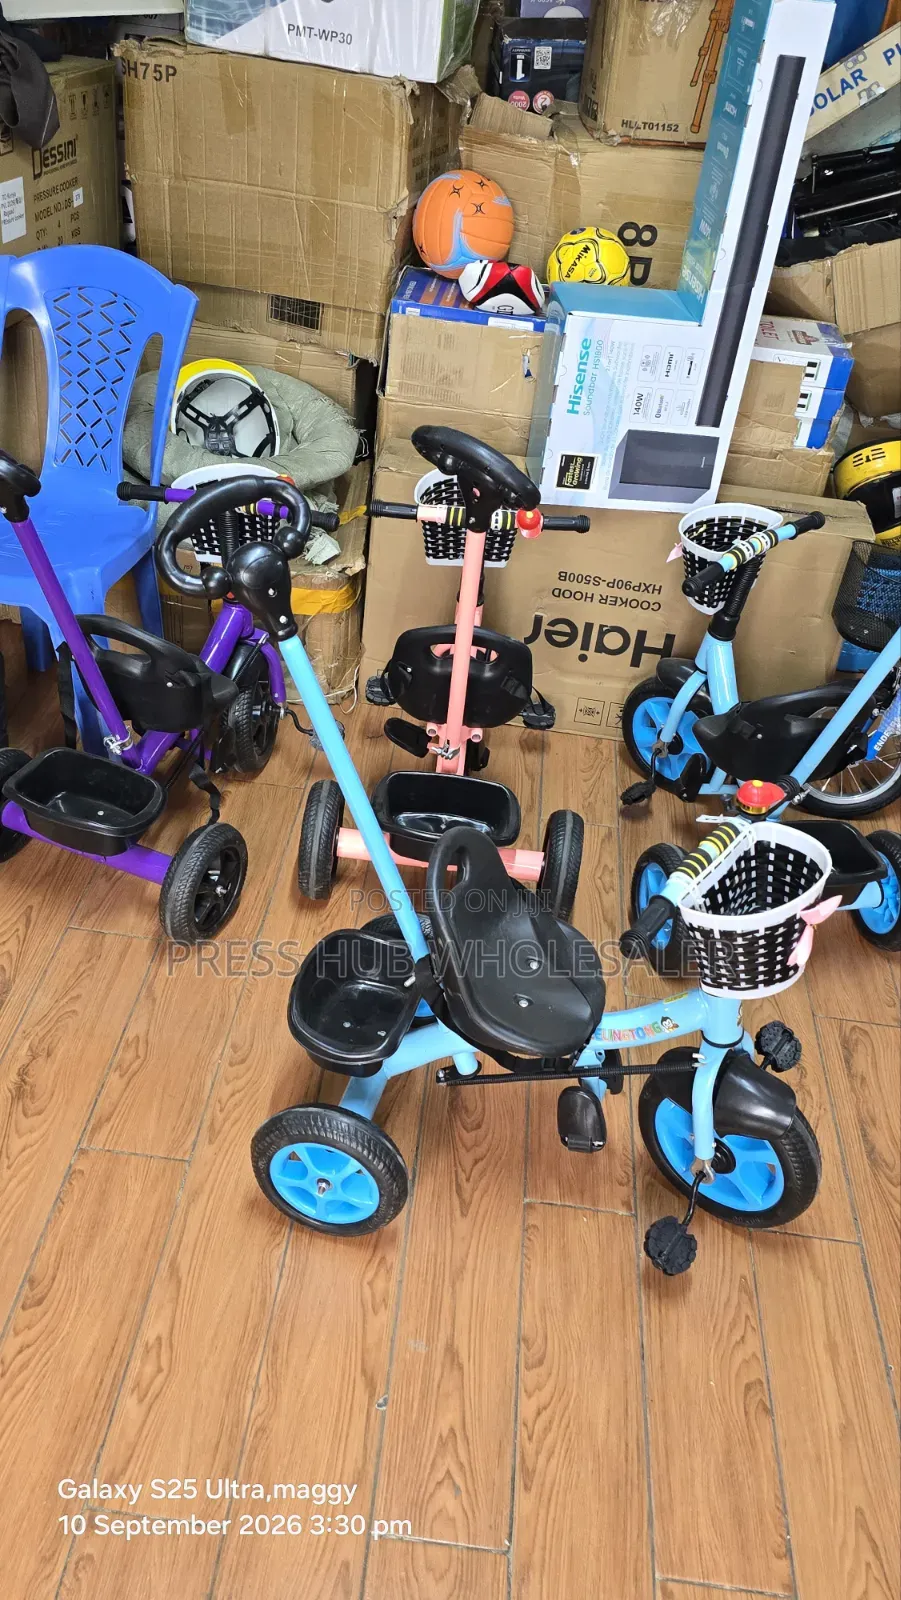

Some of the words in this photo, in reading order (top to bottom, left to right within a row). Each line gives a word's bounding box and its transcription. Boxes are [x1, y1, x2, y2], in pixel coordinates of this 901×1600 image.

[287, 23, 353, 46] PMT-WP30
[120, 55, 178, 83] SH75P
[33, 182, 59, 203] PRESSURE
[59, 176, 79, 193] COOKER
[34, 202, 53, 222] MODEL
[567, 338, 592, 416] Hisense
[583, 371, 598, 416] Soundbar
[633, 393, 644, 416] 140W
[557, 570, 663, 595] HXP90P-S500B
[551, 587, 594, 603] HOOD
[598, 593, 662, 612] COOKER
[523, 613, 676, 668] Haier
[591, 1020, 662, 1042] ELINGTONG
